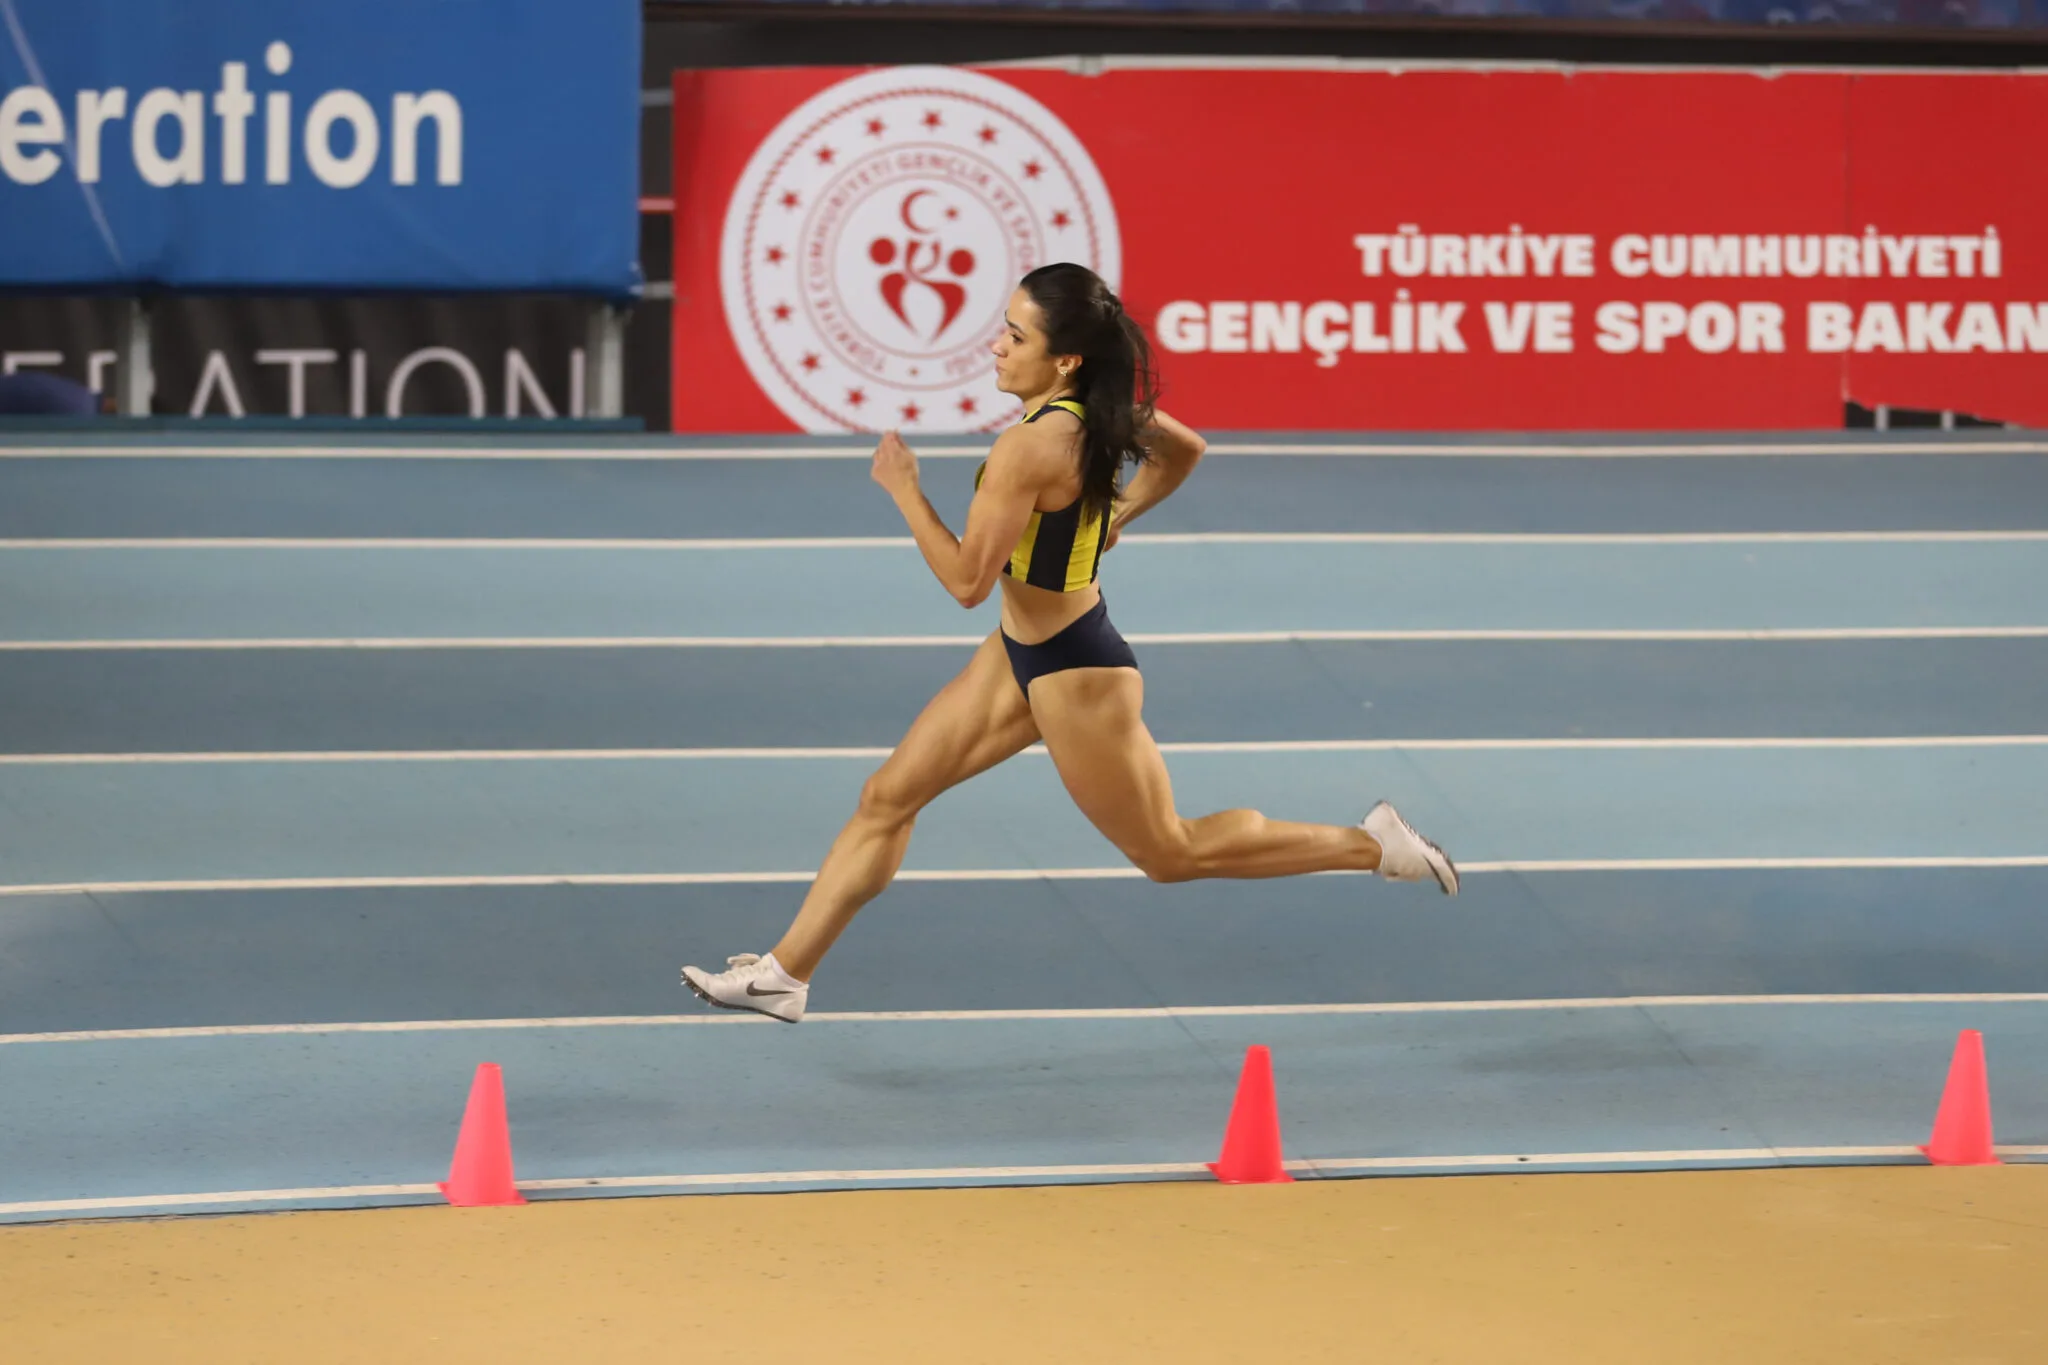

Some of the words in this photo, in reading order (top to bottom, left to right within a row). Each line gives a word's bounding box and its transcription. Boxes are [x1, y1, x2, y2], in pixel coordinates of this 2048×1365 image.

[0, 41, 463, 188] eration
[1354, 224, 1595, 278] TÜRKİYE
[1610, 224, 2001, 278] CUMHURİYETİ
[1156, 289, 1466, 367] GENÇLİK
[1484, 301, 1574, 353] VE
[1595, 300, 1785, 353] SPOR
[1807, 301, 2048, 353] BAKAN
